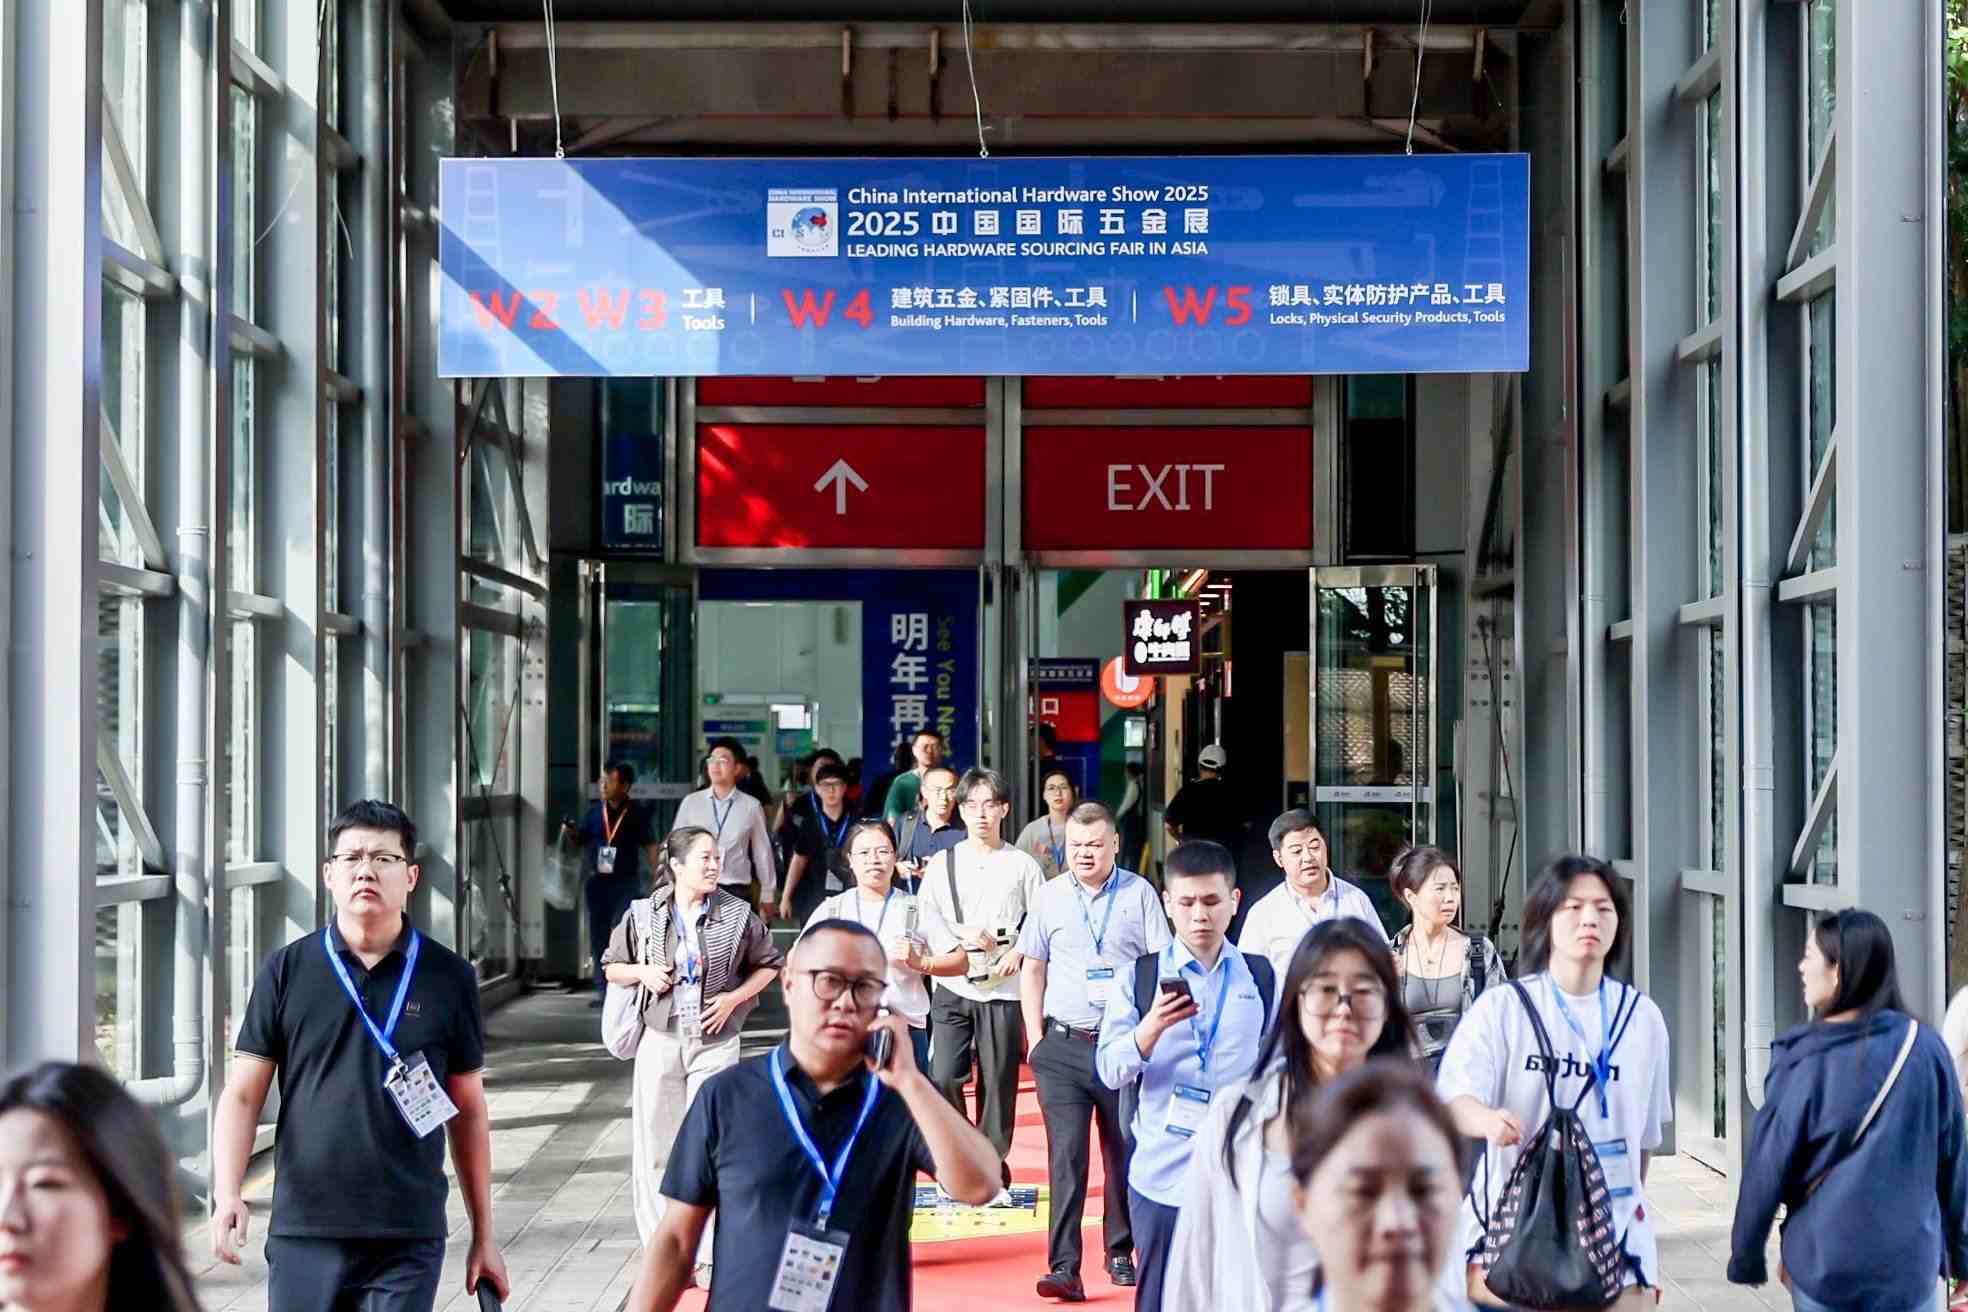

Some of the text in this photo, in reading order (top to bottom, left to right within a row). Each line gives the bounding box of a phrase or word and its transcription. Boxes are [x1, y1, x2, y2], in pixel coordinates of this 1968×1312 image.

[848, 188, 898, 204] China
[903, 187, 1017, 204] International
[1023, 186, 1107, 202] Hardware
[1112, 186, 1159, 202] Show
[1164, 186, 1209, 201] 2025
[848, 211, 920, 236] 2025
[848, 241, 1209, 257] LEADING HARDWARE SOURCING FAIR IN ASIA
[681, 287, 726, 309] 工具
[890, 286, 1107, 309] 建筑五金、紧固件、工具
[1269, 283, 1506, 306] 锁具、实体防护产品、工具
[682, 315, 726, 330] Tools
[890, 313, 1108, 329] Building Hardware, Fasteners, Tools
[1270, 310, 1506, 327] Locks, Physical Security Products, Tools
[1107, 464, 1225, 511] EXIT
[937, 616, 955, 651] See
[890, 613, 929, 765] 明年再
[937, 658, 956, 699] You
